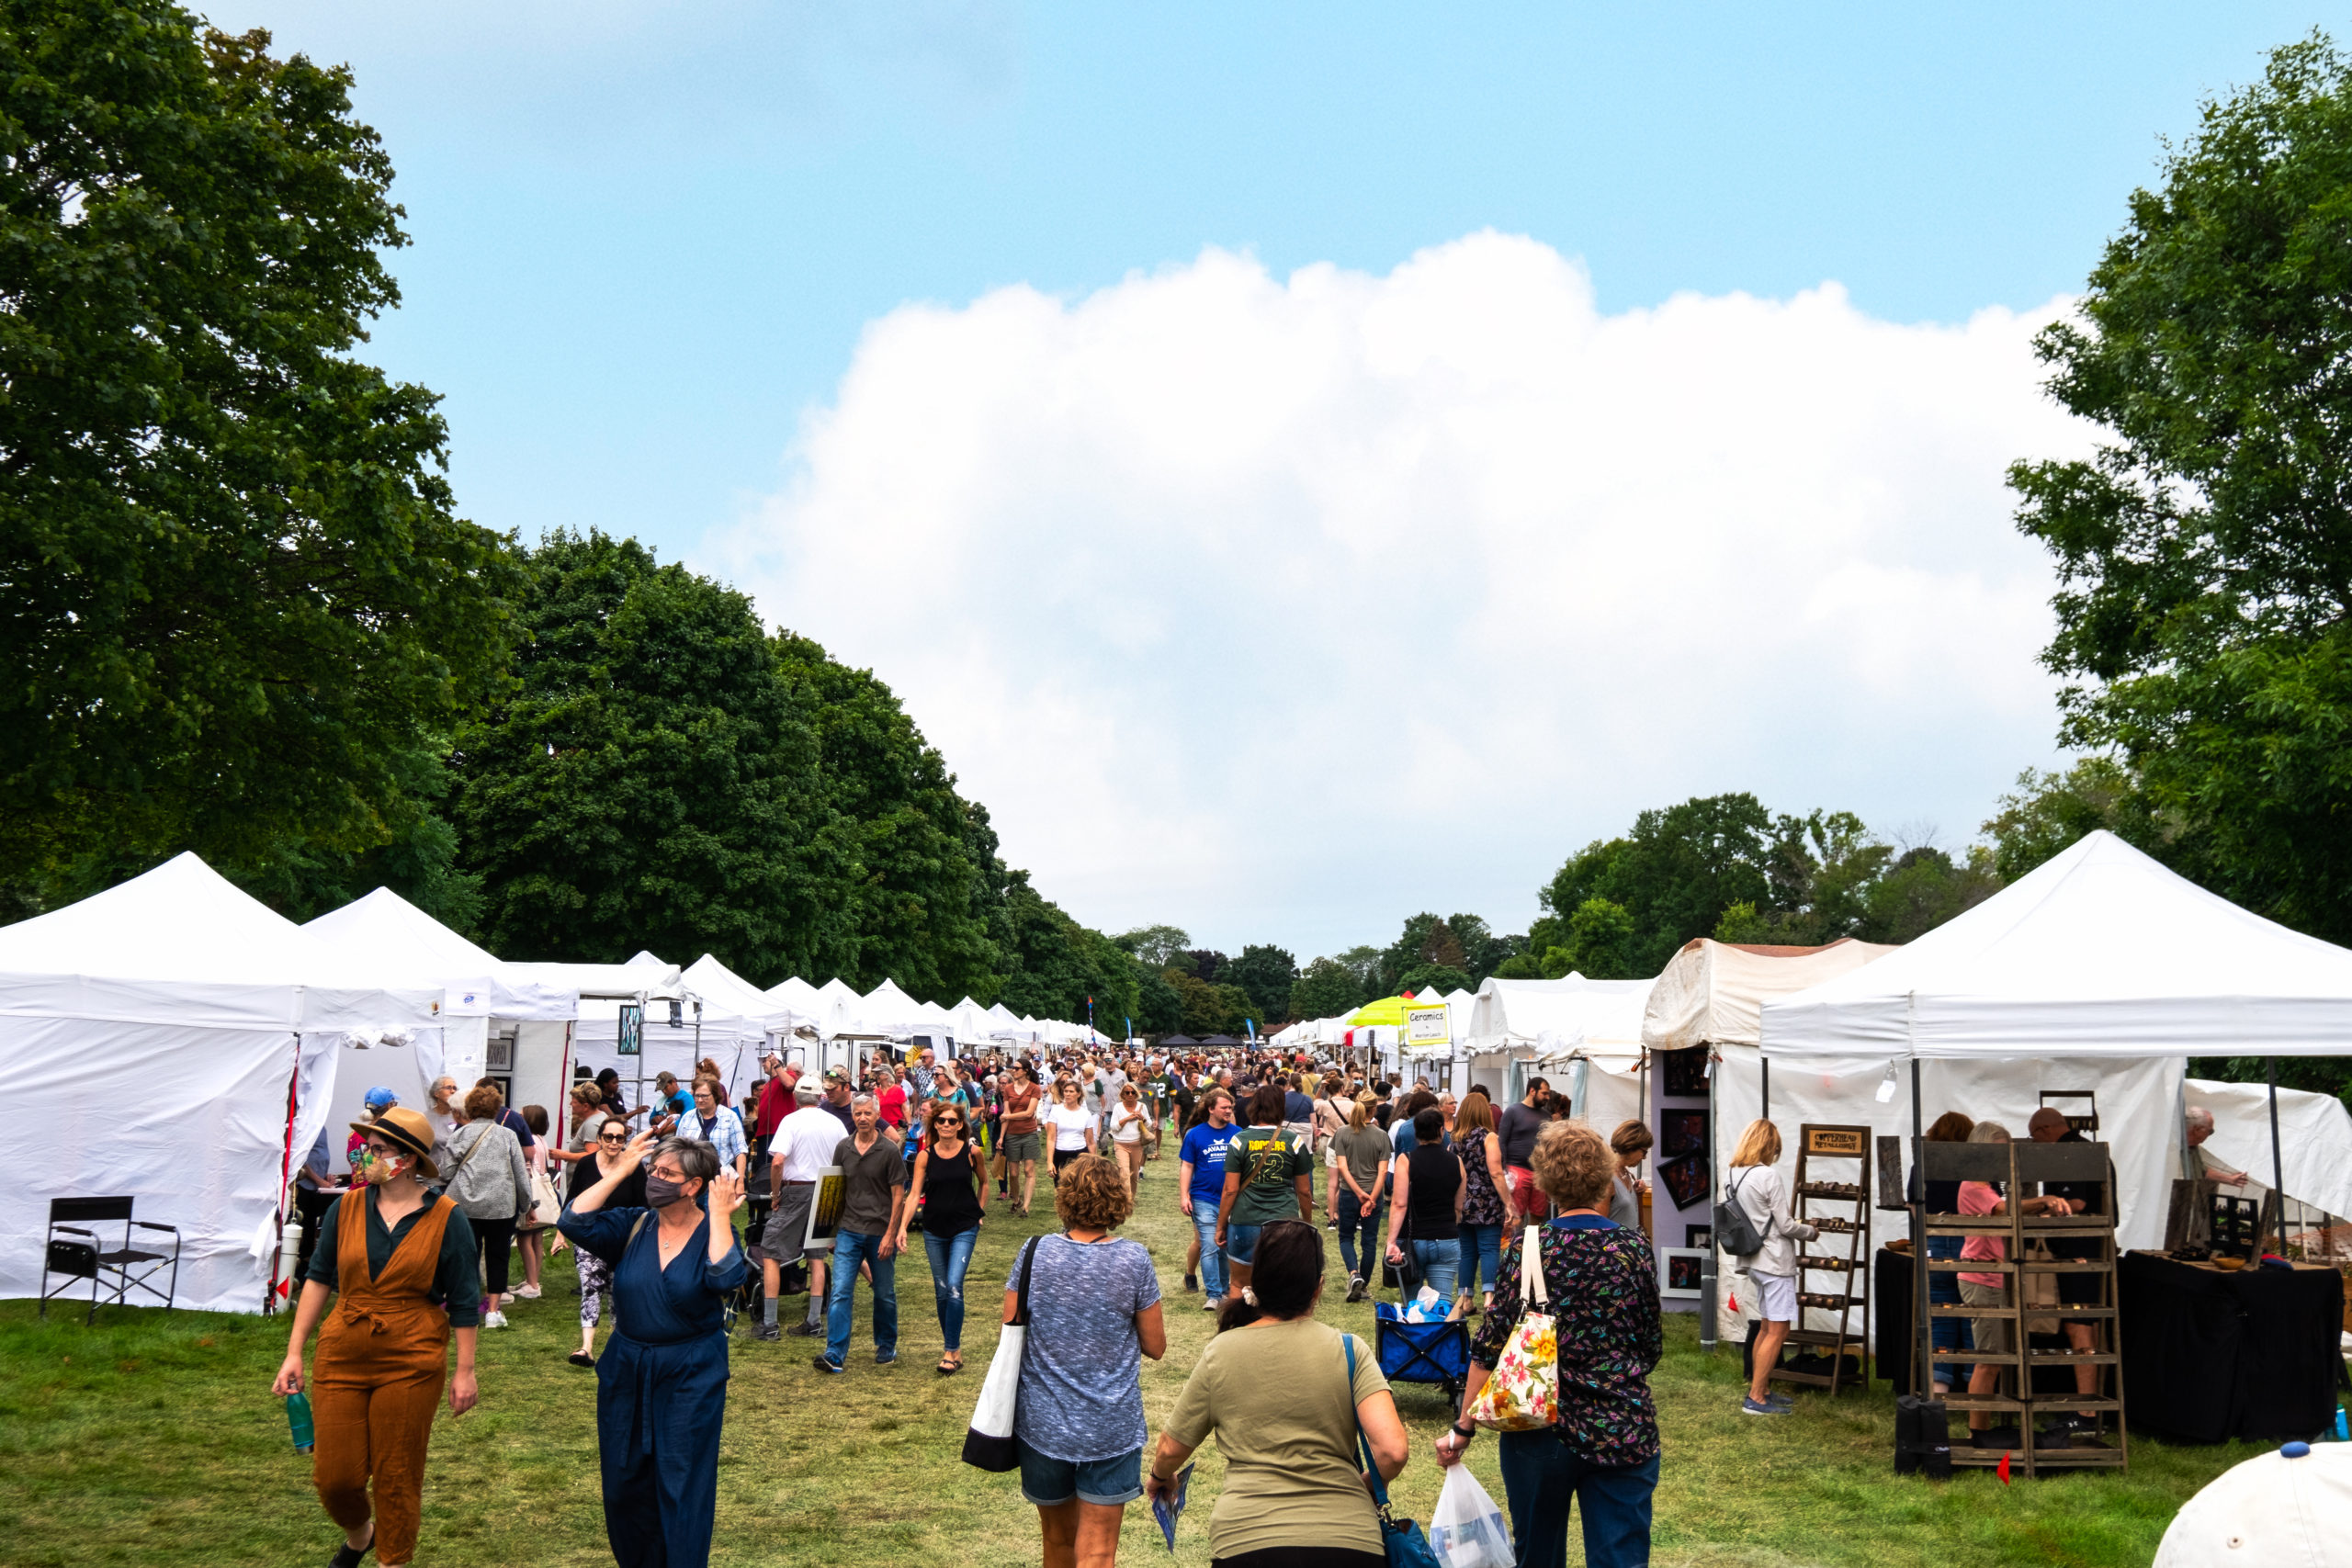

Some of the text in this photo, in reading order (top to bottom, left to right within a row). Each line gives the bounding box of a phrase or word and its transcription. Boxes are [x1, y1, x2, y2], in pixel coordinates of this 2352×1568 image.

[1409, 1012, 1443, 1021] Ceramics
[1815, 1133, 1857, 1142] COPPERHEAD
[1203, 1145, 1227, 1156] BAVARI
[1249, 1140, 1286, 1152] RODRS
[1250, 1153, 1284, 1184] 12
